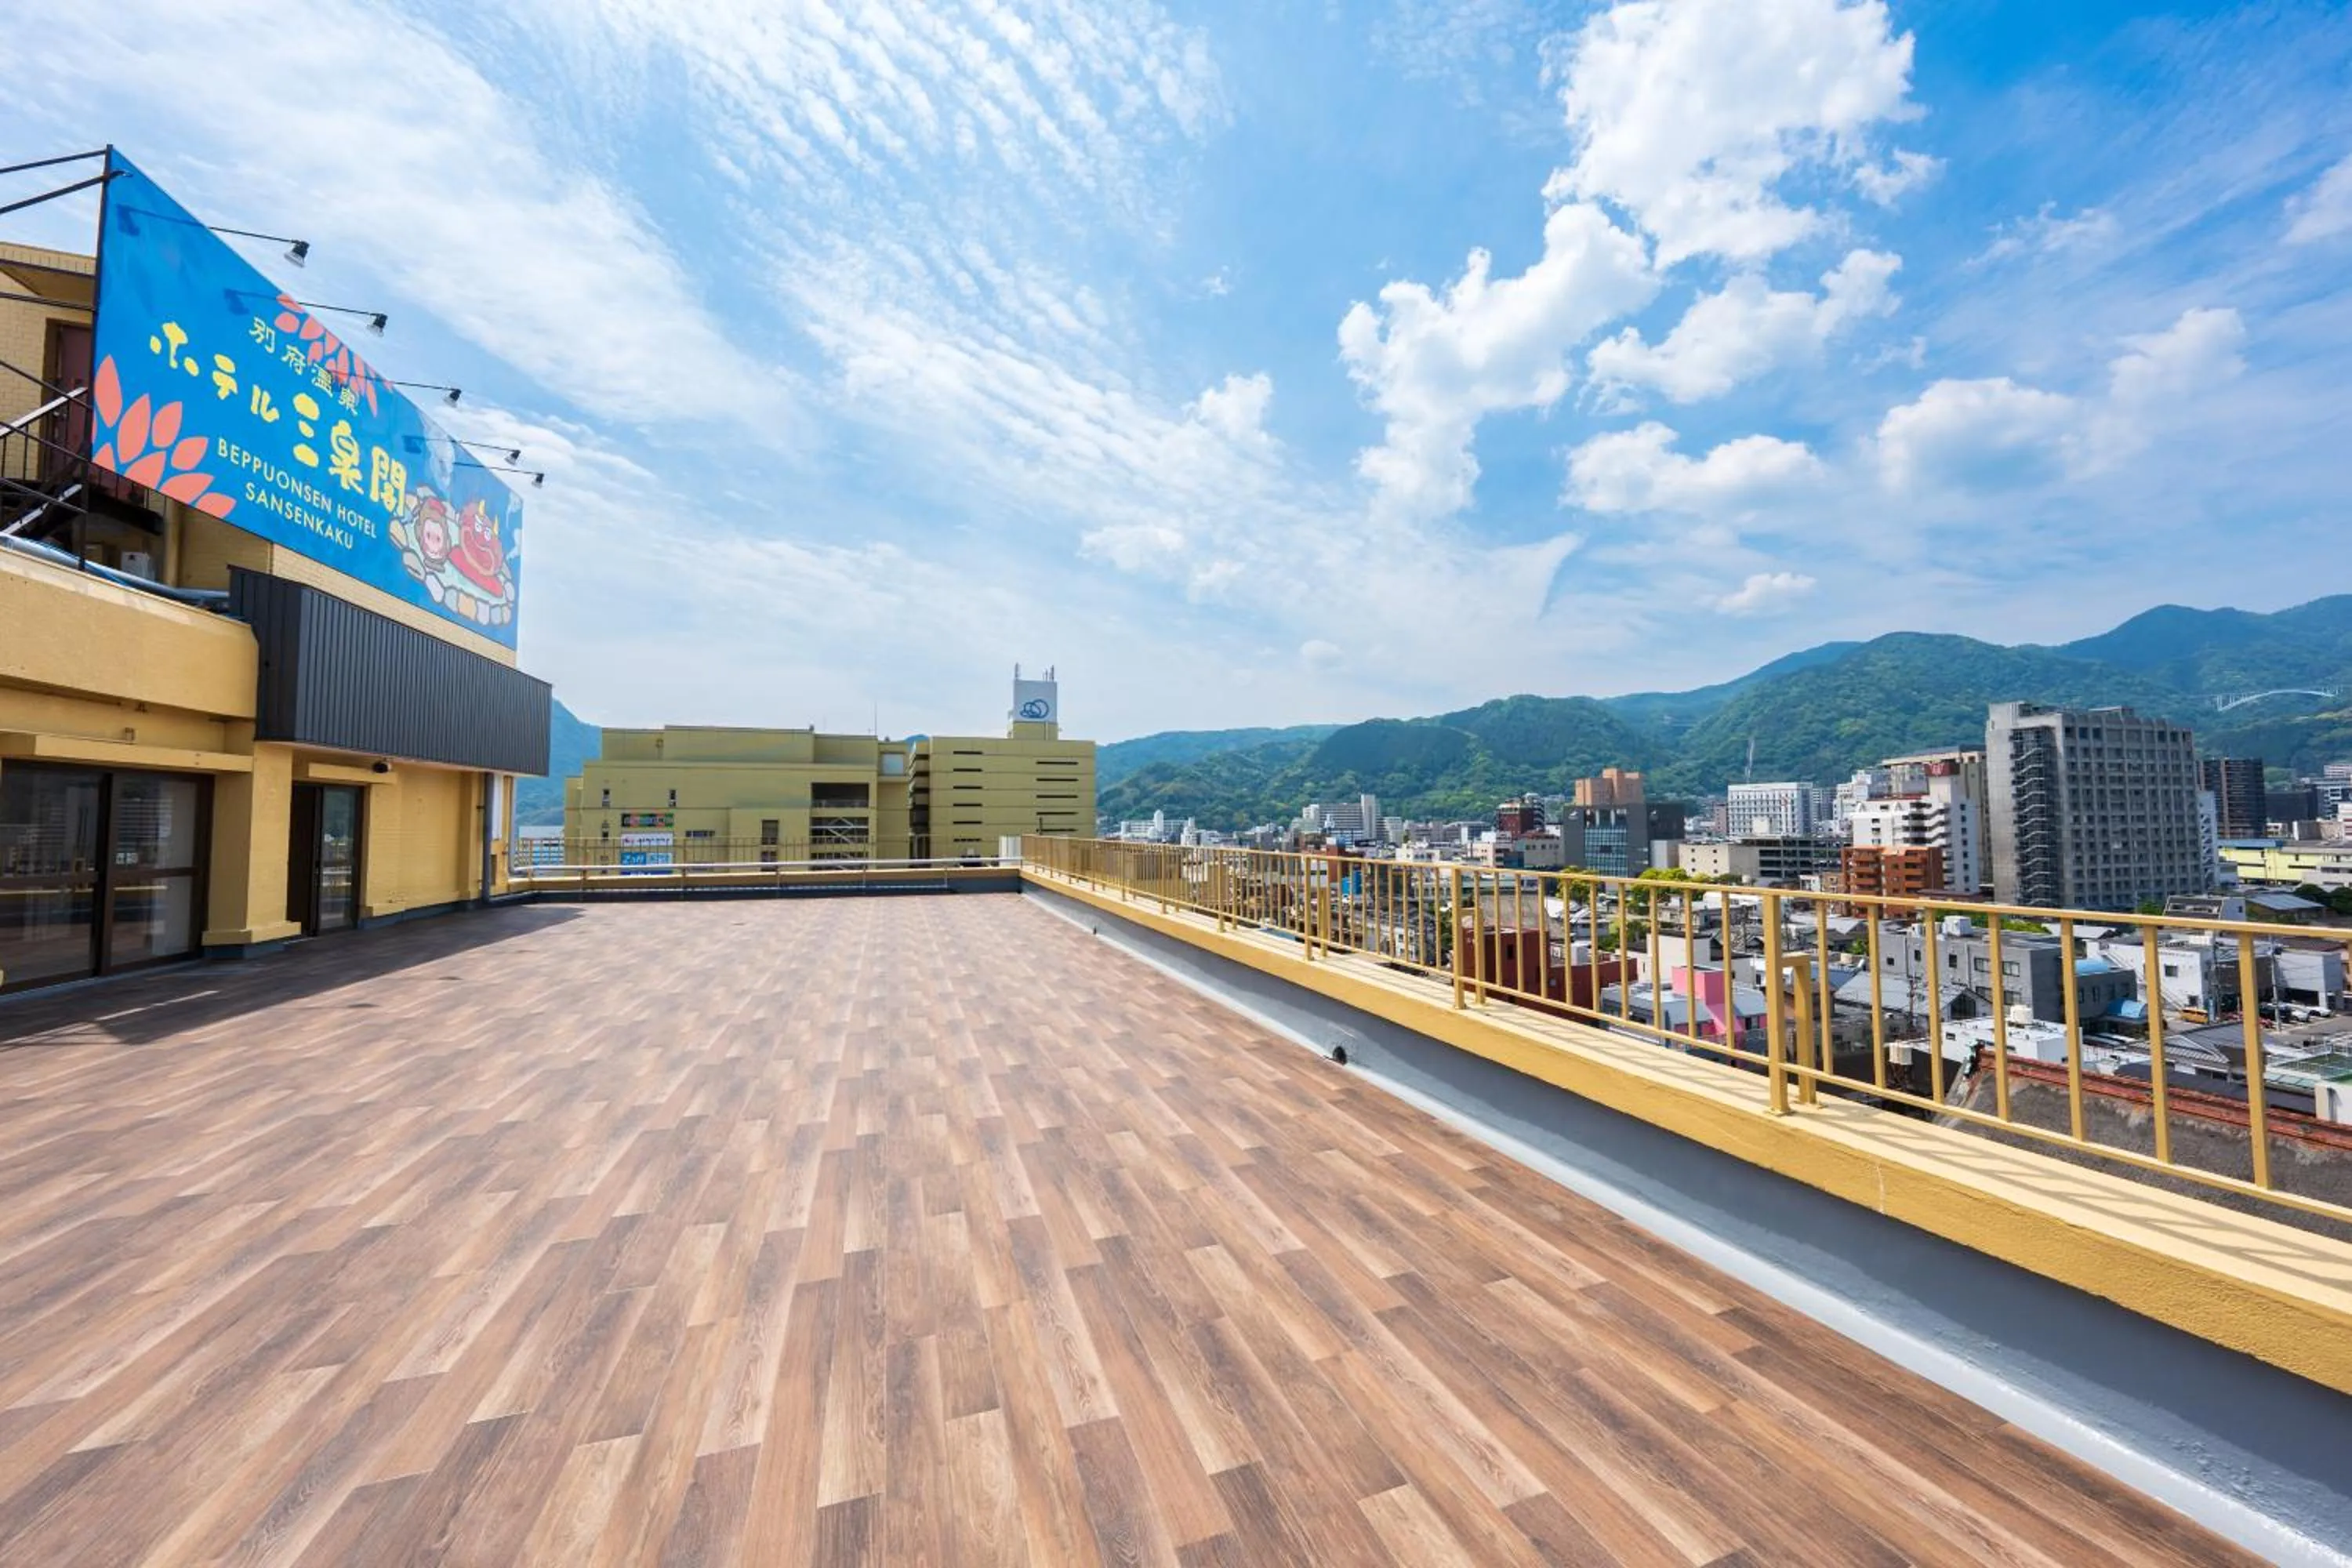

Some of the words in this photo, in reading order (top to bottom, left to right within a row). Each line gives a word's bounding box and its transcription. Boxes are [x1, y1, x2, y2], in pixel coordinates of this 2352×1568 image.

[249, 316, 358, 416] 別府温泉
[150, 321, 406, 515] ホテル三泉閣
[218, 437, 332, 514] BEPPUONSEN
[337, 504, 376, 539] HOTEL
[245, 482, 353, 550] SANSENKAKU
